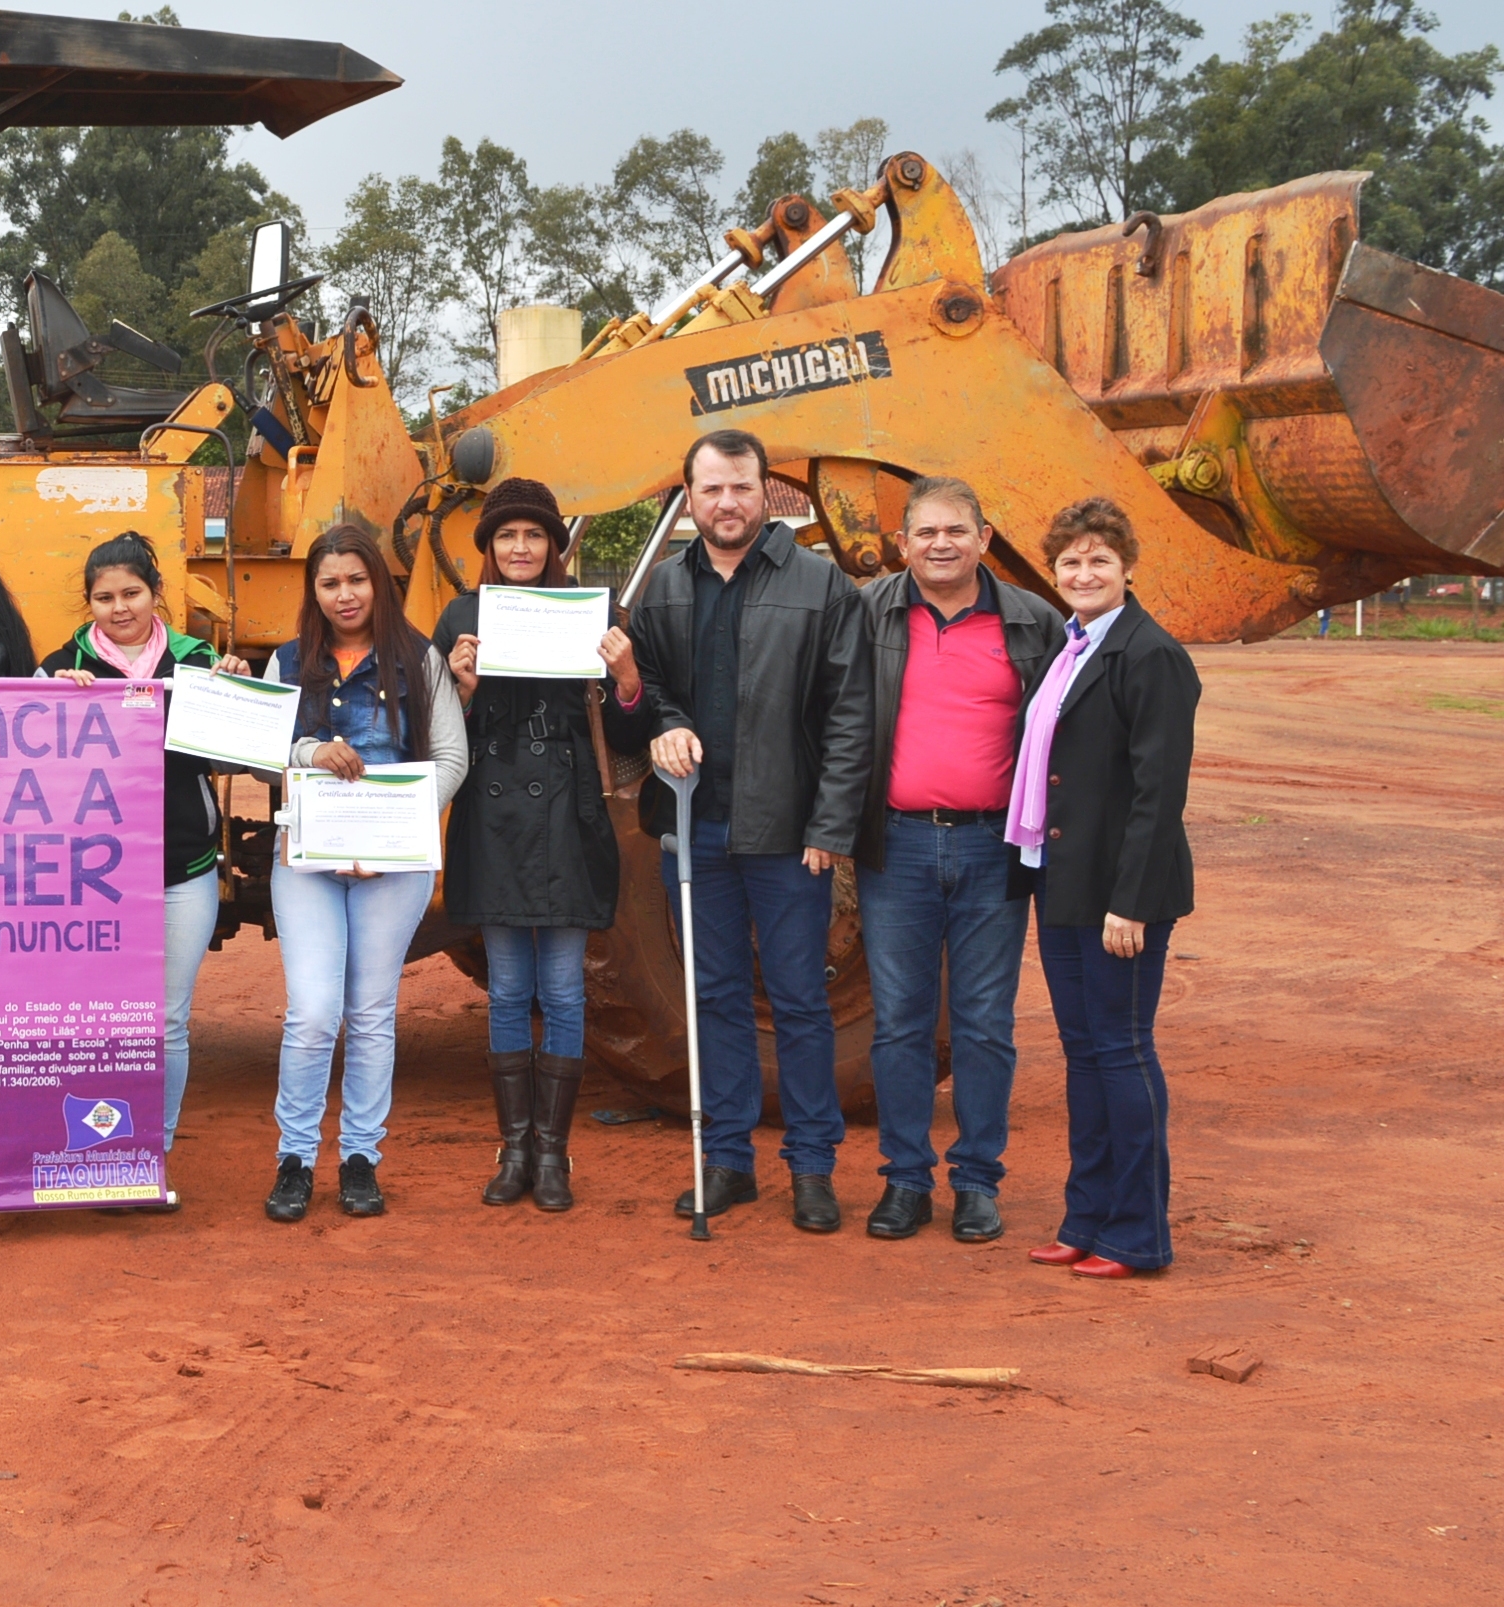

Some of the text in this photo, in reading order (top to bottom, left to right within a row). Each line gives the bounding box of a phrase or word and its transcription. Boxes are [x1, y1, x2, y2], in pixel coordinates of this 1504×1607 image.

[73, 768, 123, 825] A
[318, 790, 354, 799] Certificado
[365, 791, 416, 799] Aproveitamento
[5, 1003, 18, 1012] do
[26, 1002, 61, 1011] Estado
[69, 1002, 81, 1011] de
[89, 1001, 114, 1011] Mato
[121, 1001, 155, 1010] Grosso
[13, 1016, 29, 1027] por
[35, 1014, 58, 1024] meio
[64, 1014, 76, 1023] da
[81, 1013, 95, 1023] Lei
[101, 1012, 155, 1023] 4.969/2016,
[8, 1027, 46, 1039] "Agosto
[53, 1026, 79, 1036] Lilás"
[111, 1026, 155, 1037] programa
[37, 1039, 51, 1048] vai
[72, 1038, 112, 1049] Escola",
[119, 1037, 155, 1047] visando
[12, 1052, 61, 1061] sociedade
[69, 1051, 95, 1060] sobre
[102, 1052, 108, 1060] a
[115, 1050, 155, 1059] violência
[0, 1064, 37, 1076] familiar,
[48, 1063, 86, 1075] divulgar
[98, 1062, 113, 1072] Lei
[115, 1062, 141, 1071] Maria
[144, 1061, 155, 1071] da
[33, 1147, 151, 1164] Prefeitura Municipal de
[33, 1156, 159, 1189] ITAQUIRAÍ
[36, 1187, 157, 1201] Nosso Rumo é Para Frente
